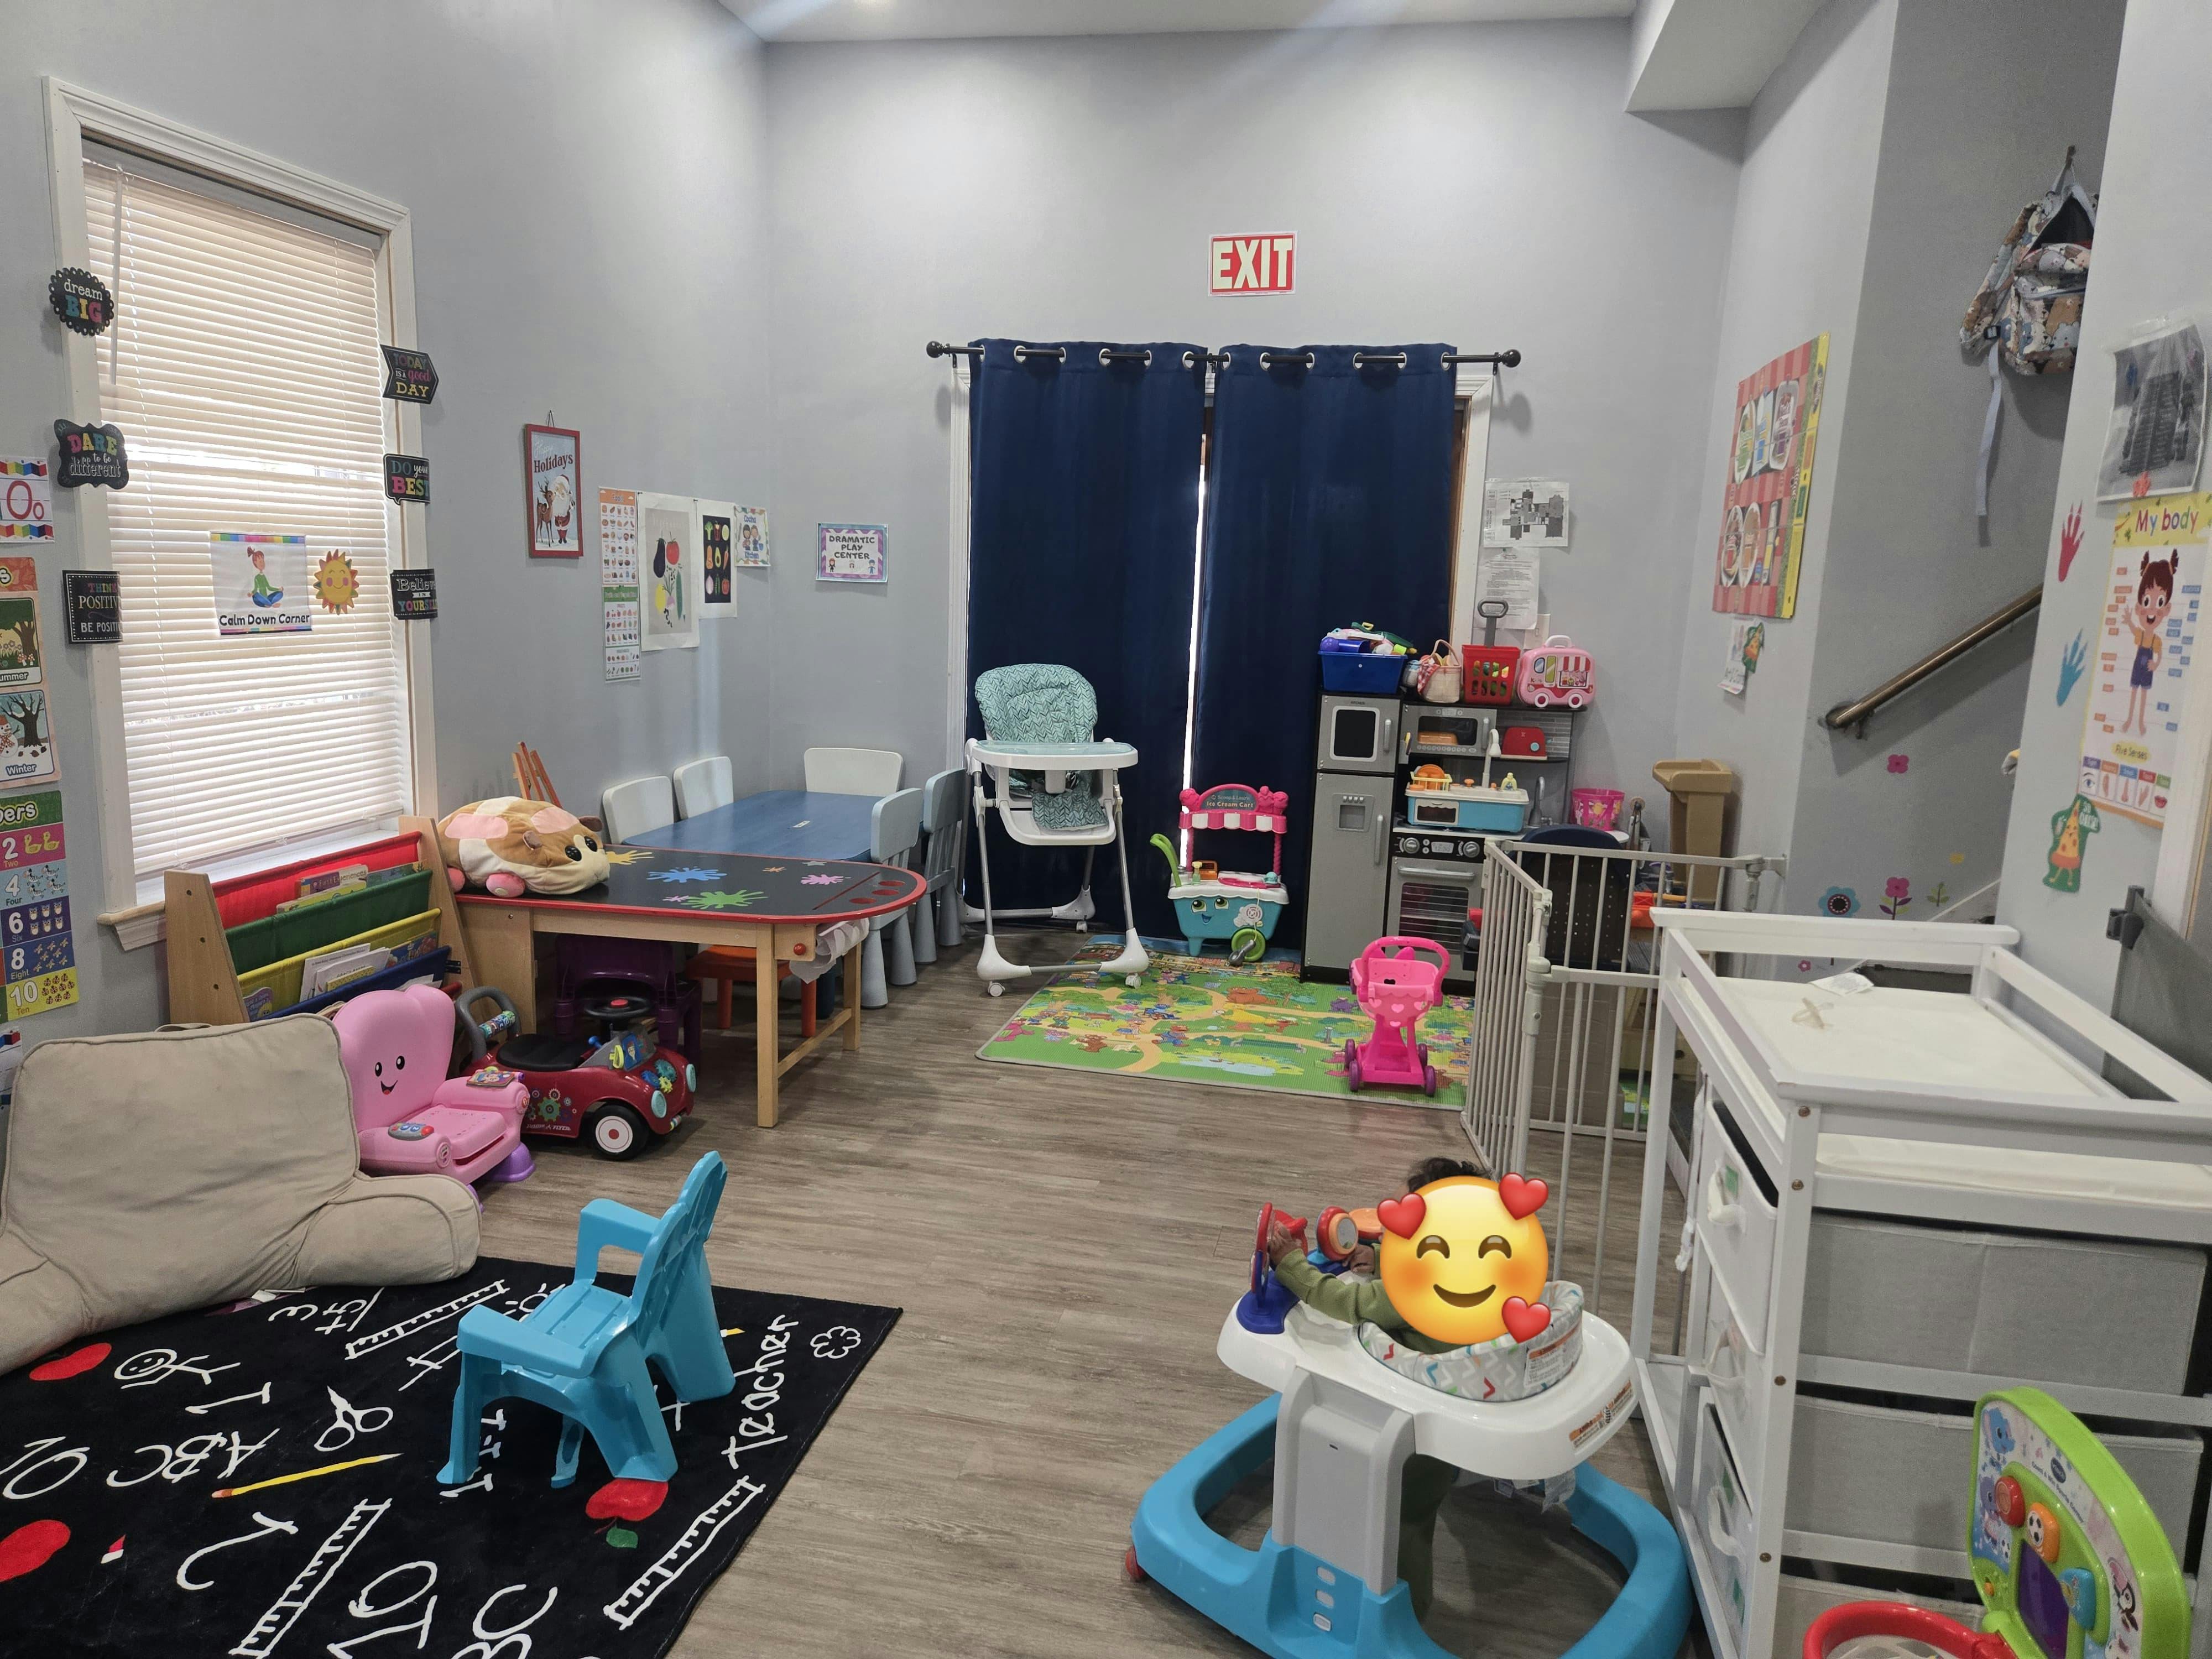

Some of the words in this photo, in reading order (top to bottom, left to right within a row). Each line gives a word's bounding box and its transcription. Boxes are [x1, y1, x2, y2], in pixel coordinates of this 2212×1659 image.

[1212, 238, 1293, 289] EXIT
[64, 278, 102, 301] dream
[65, 294, 102, 323] BIG
[393, 353, 427, 370] TODAY
[408, 369, 431, 383] good
[396, 382, 429, 398] DAY
[67, 432, 117, 456] DARE
[93, 452, 101, 462] to
[103, 453, 112, 463] be
[534, 454, 573, 473] Holidays
[70, 457, 121, 478] different
[390, 460, 411, 476] DO
[392, 476, 430, 497] BEST
[2136, 508, 2158, 537] My
[2161, 505, 2199, 534] body
[829, 535, 875, 544] DRAMATIC
[834, 551, 870, 560] CENTER
[78, 595, 121, 609] POSITIV
[81, 622, 93, 633] BE
[219, 614, 246, 626] Calm
[248, 614, 276, 625] Down
[278, 613, 310, 624] Corner
[0, 672, 28, 682] ummer
[6, 764, 36, 776] Winter
[2, 837, 18, 860] 2
[4, 874, 20, 897] 4
[6, 897, 23, 906] Four
[9, 912, 23, 935] 6
[11, 948, 25, 971] 8
[11, 969, 29, 980] Eight
[10, 980, 39, 1008] 10
[17, 1007, 30, 1015] Ten
[106, 1428, 280, 1487] ABC
